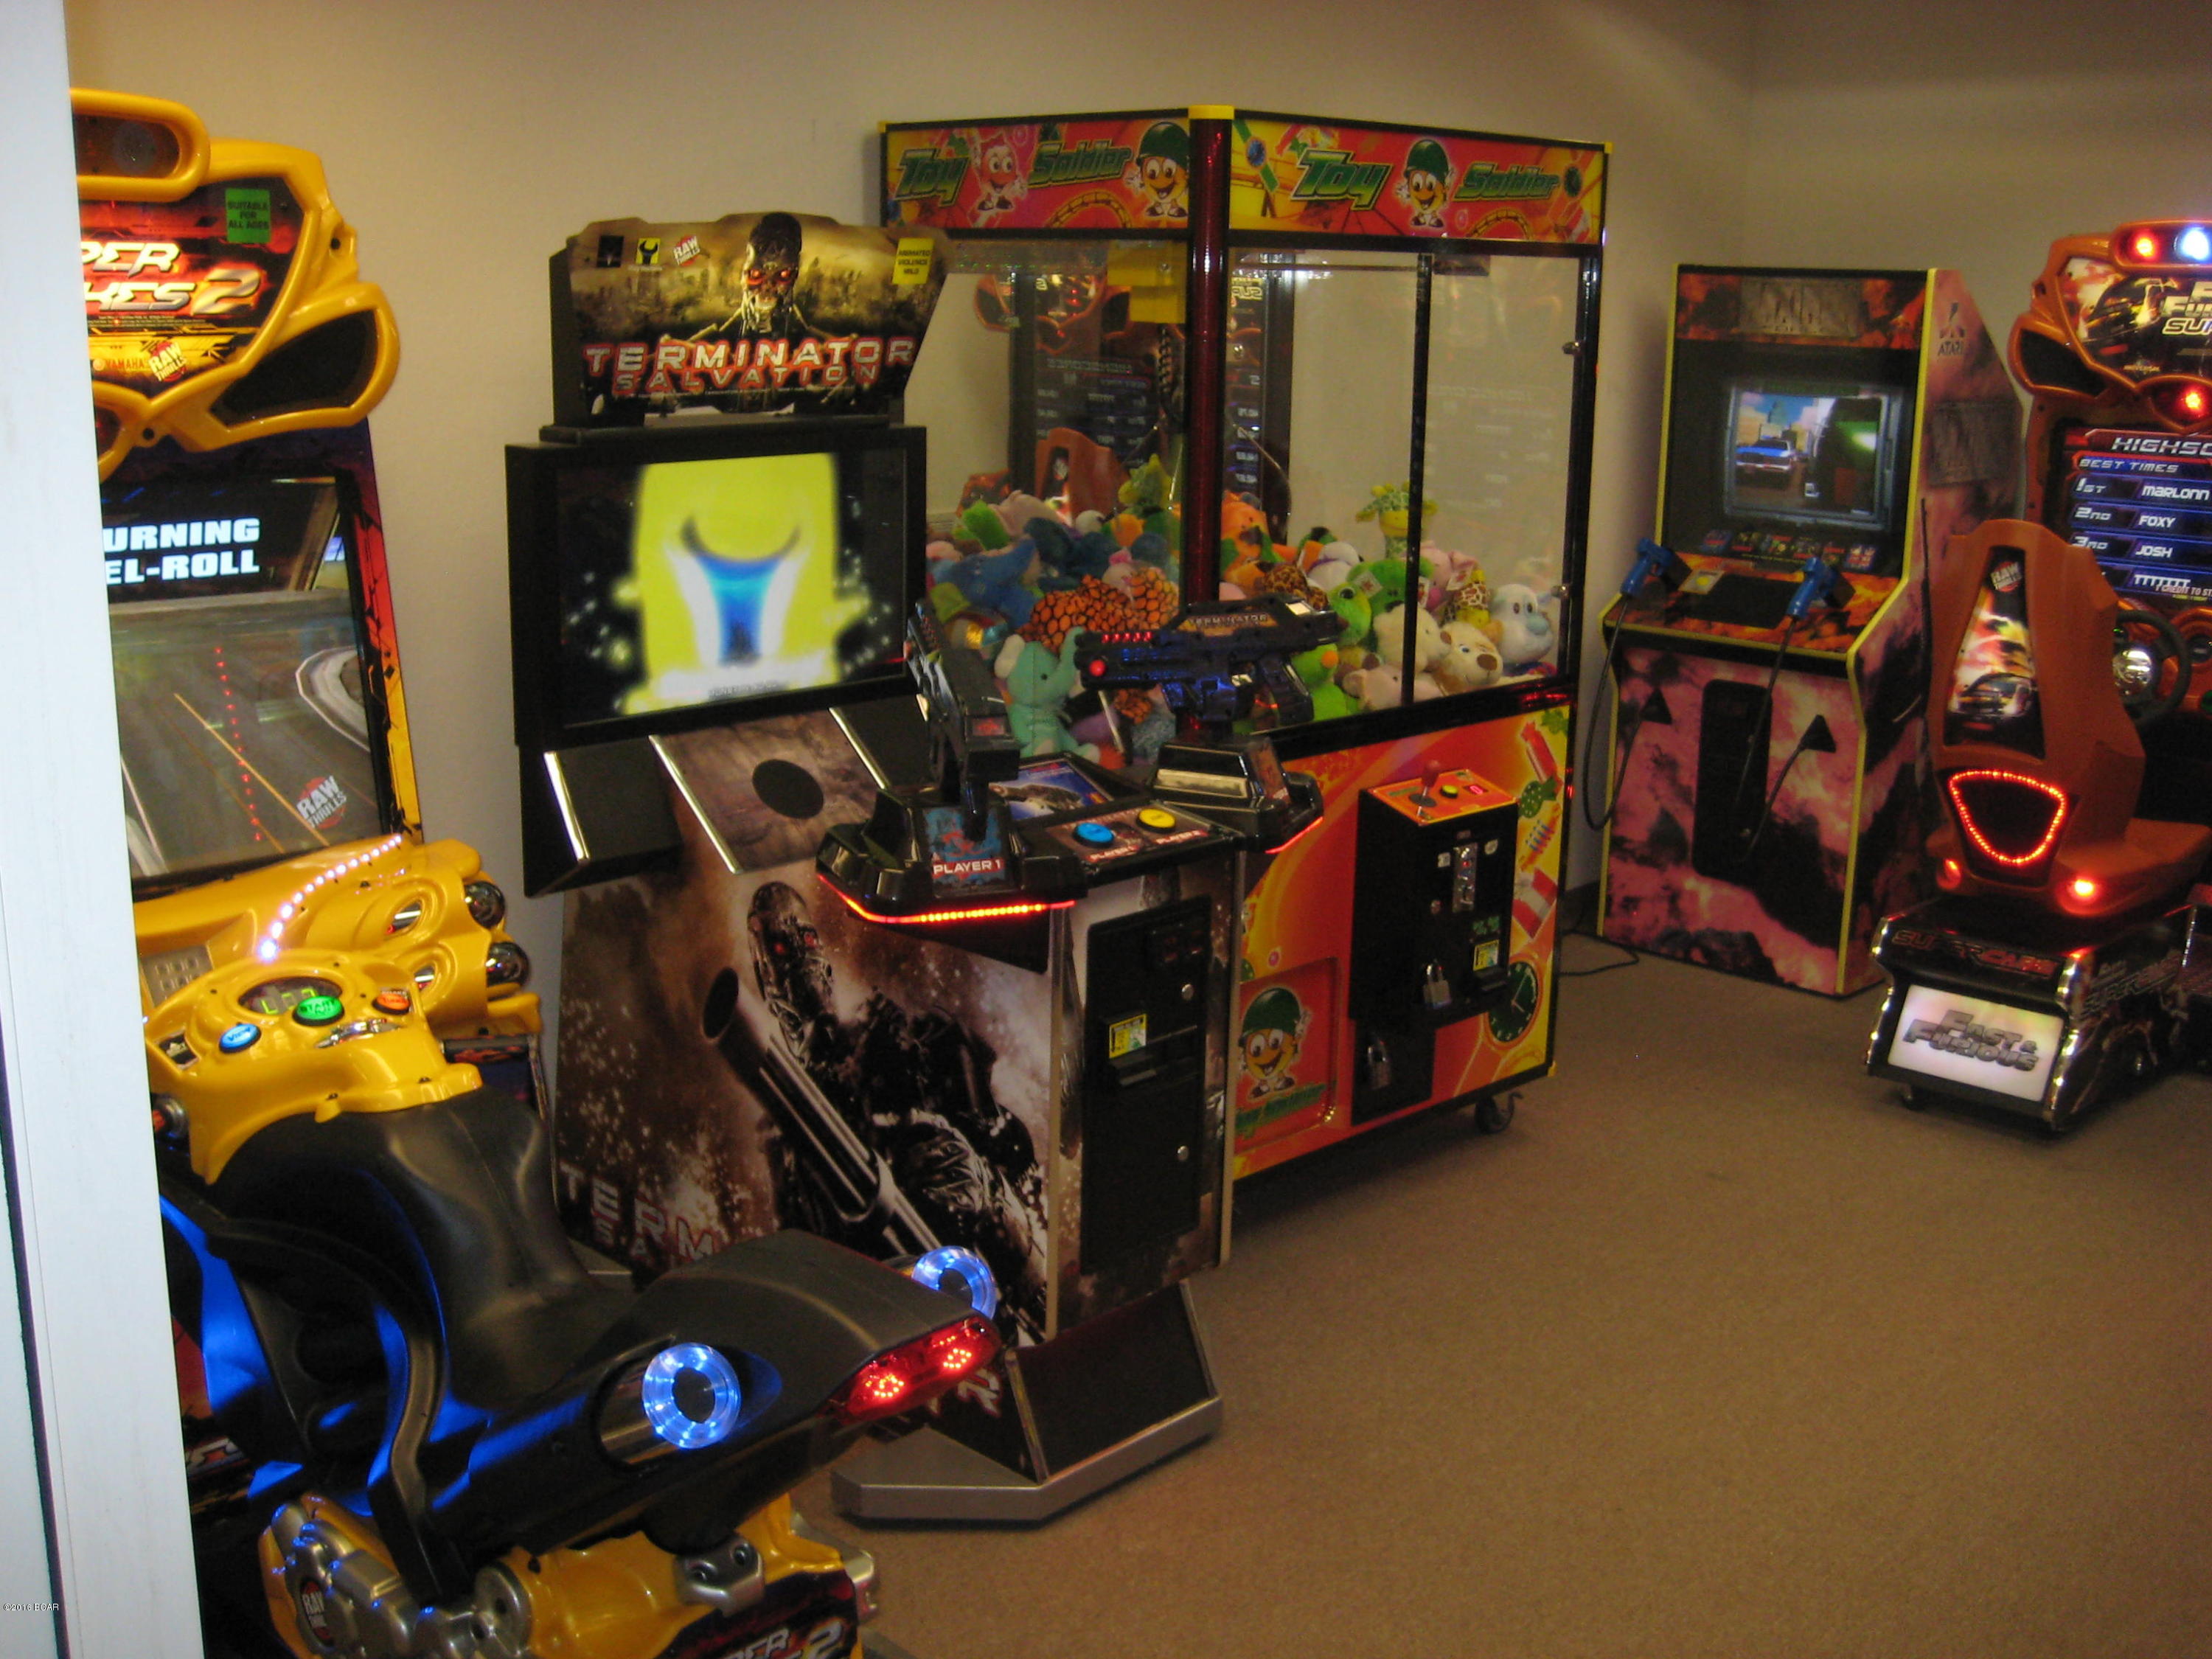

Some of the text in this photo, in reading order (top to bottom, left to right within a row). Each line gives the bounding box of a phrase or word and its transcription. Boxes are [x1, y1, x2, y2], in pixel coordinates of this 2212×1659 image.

[893, 139, 1133, 206] Toy Soldier
[1291, 147, 1559, 211] Toy Soldier
[81, 241, 181, 278] PER
[673, 236, 698, 260] RAW
[191, 268, 260, 315] 2
[105, 358, 145, 369] YAMAHA
[148, 341, 182, 375] RAW
[585, 338, 915, 375] TERMINATOR
[1938, 340, 1965, 357] ATARI
[614, 364, 877, 392] SALVATION
[2079, 458, 2180, 473] BEST TIMES
[2138, 515, 2177, 529] FOXY
[2135, 545, 2174, 558] JOSH
[2191, 587, 2202, 596] TO
[296, 775, 339, 820] RAW
[307, 790, 347, 829] THRILLS
[933, 859, 1001, 874] PLAYER 1
[1902, 1019, 2039, 1071] FURIOUS
[1936, 1009, 2037, 1054] FAST &
